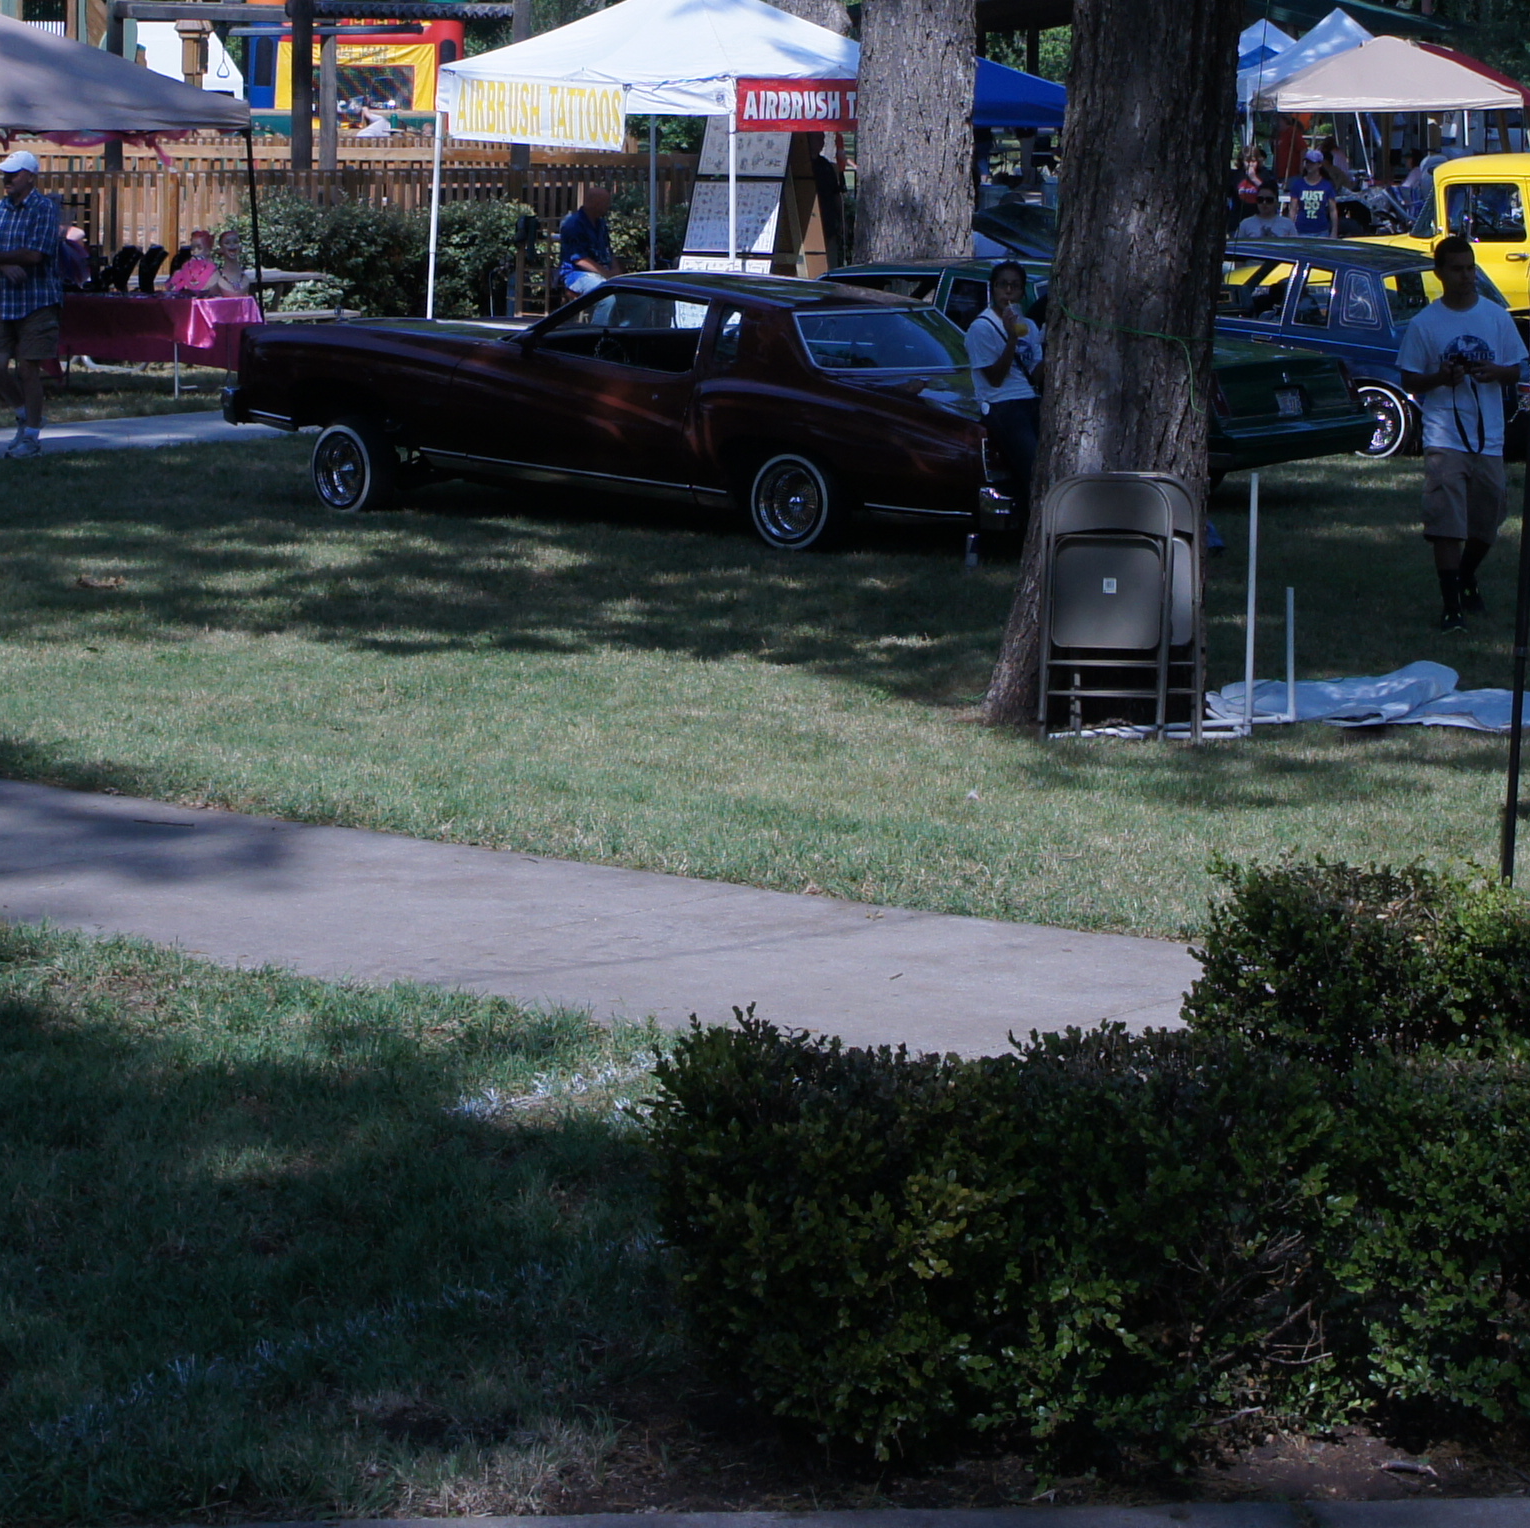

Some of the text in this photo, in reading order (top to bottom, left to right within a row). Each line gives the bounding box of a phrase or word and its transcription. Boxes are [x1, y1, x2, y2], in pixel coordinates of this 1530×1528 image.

[456, 78, 623, 146] AIRBRUSH TATTOOS
[742, 90, 842, 121] AIRBRUSH
[1300, 189, 1325, 202] JUST
